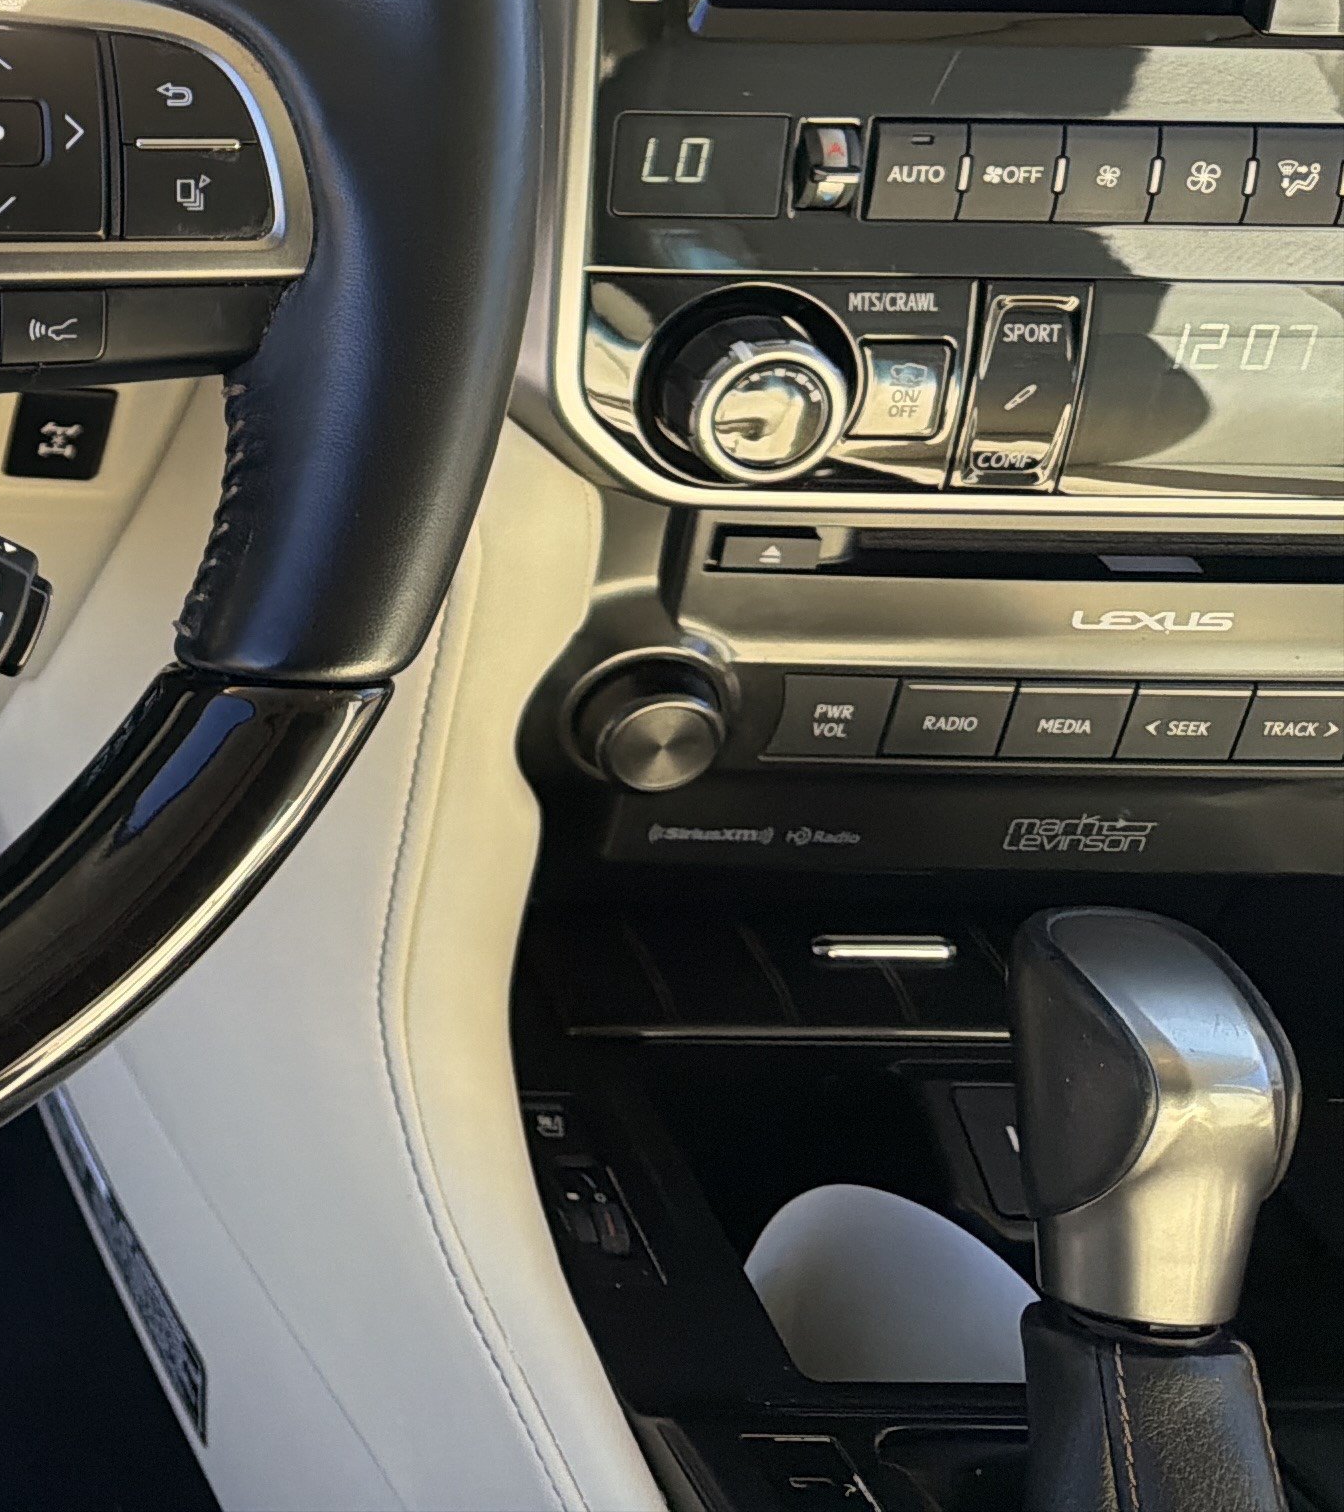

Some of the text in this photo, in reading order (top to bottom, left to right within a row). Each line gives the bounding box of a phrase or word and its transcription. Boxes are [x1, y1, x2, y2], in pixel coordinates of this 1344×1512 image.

[887, 165, 946, 184] AUTO
[1002, 165, 1044, 184] OFF
[848, 292, 939, 312] MTS/CRAWL
[1003, 324, 1063, 343] SPORT
[891, 389, 922, 404] ON/
[888, 405, 920, 419] OFF
[1072, 609, 1235, 633] LEXUS
[814, 704, 854, 722] PWR
[812, 722, 847, 739] VOL
[922, 714, 978, 733] RADIO
[1037, 718, 1092, 736] MEDIA
[1166, 720, 1211, 737] SEEK
[1261, 720, 1320, 738] TRACK
